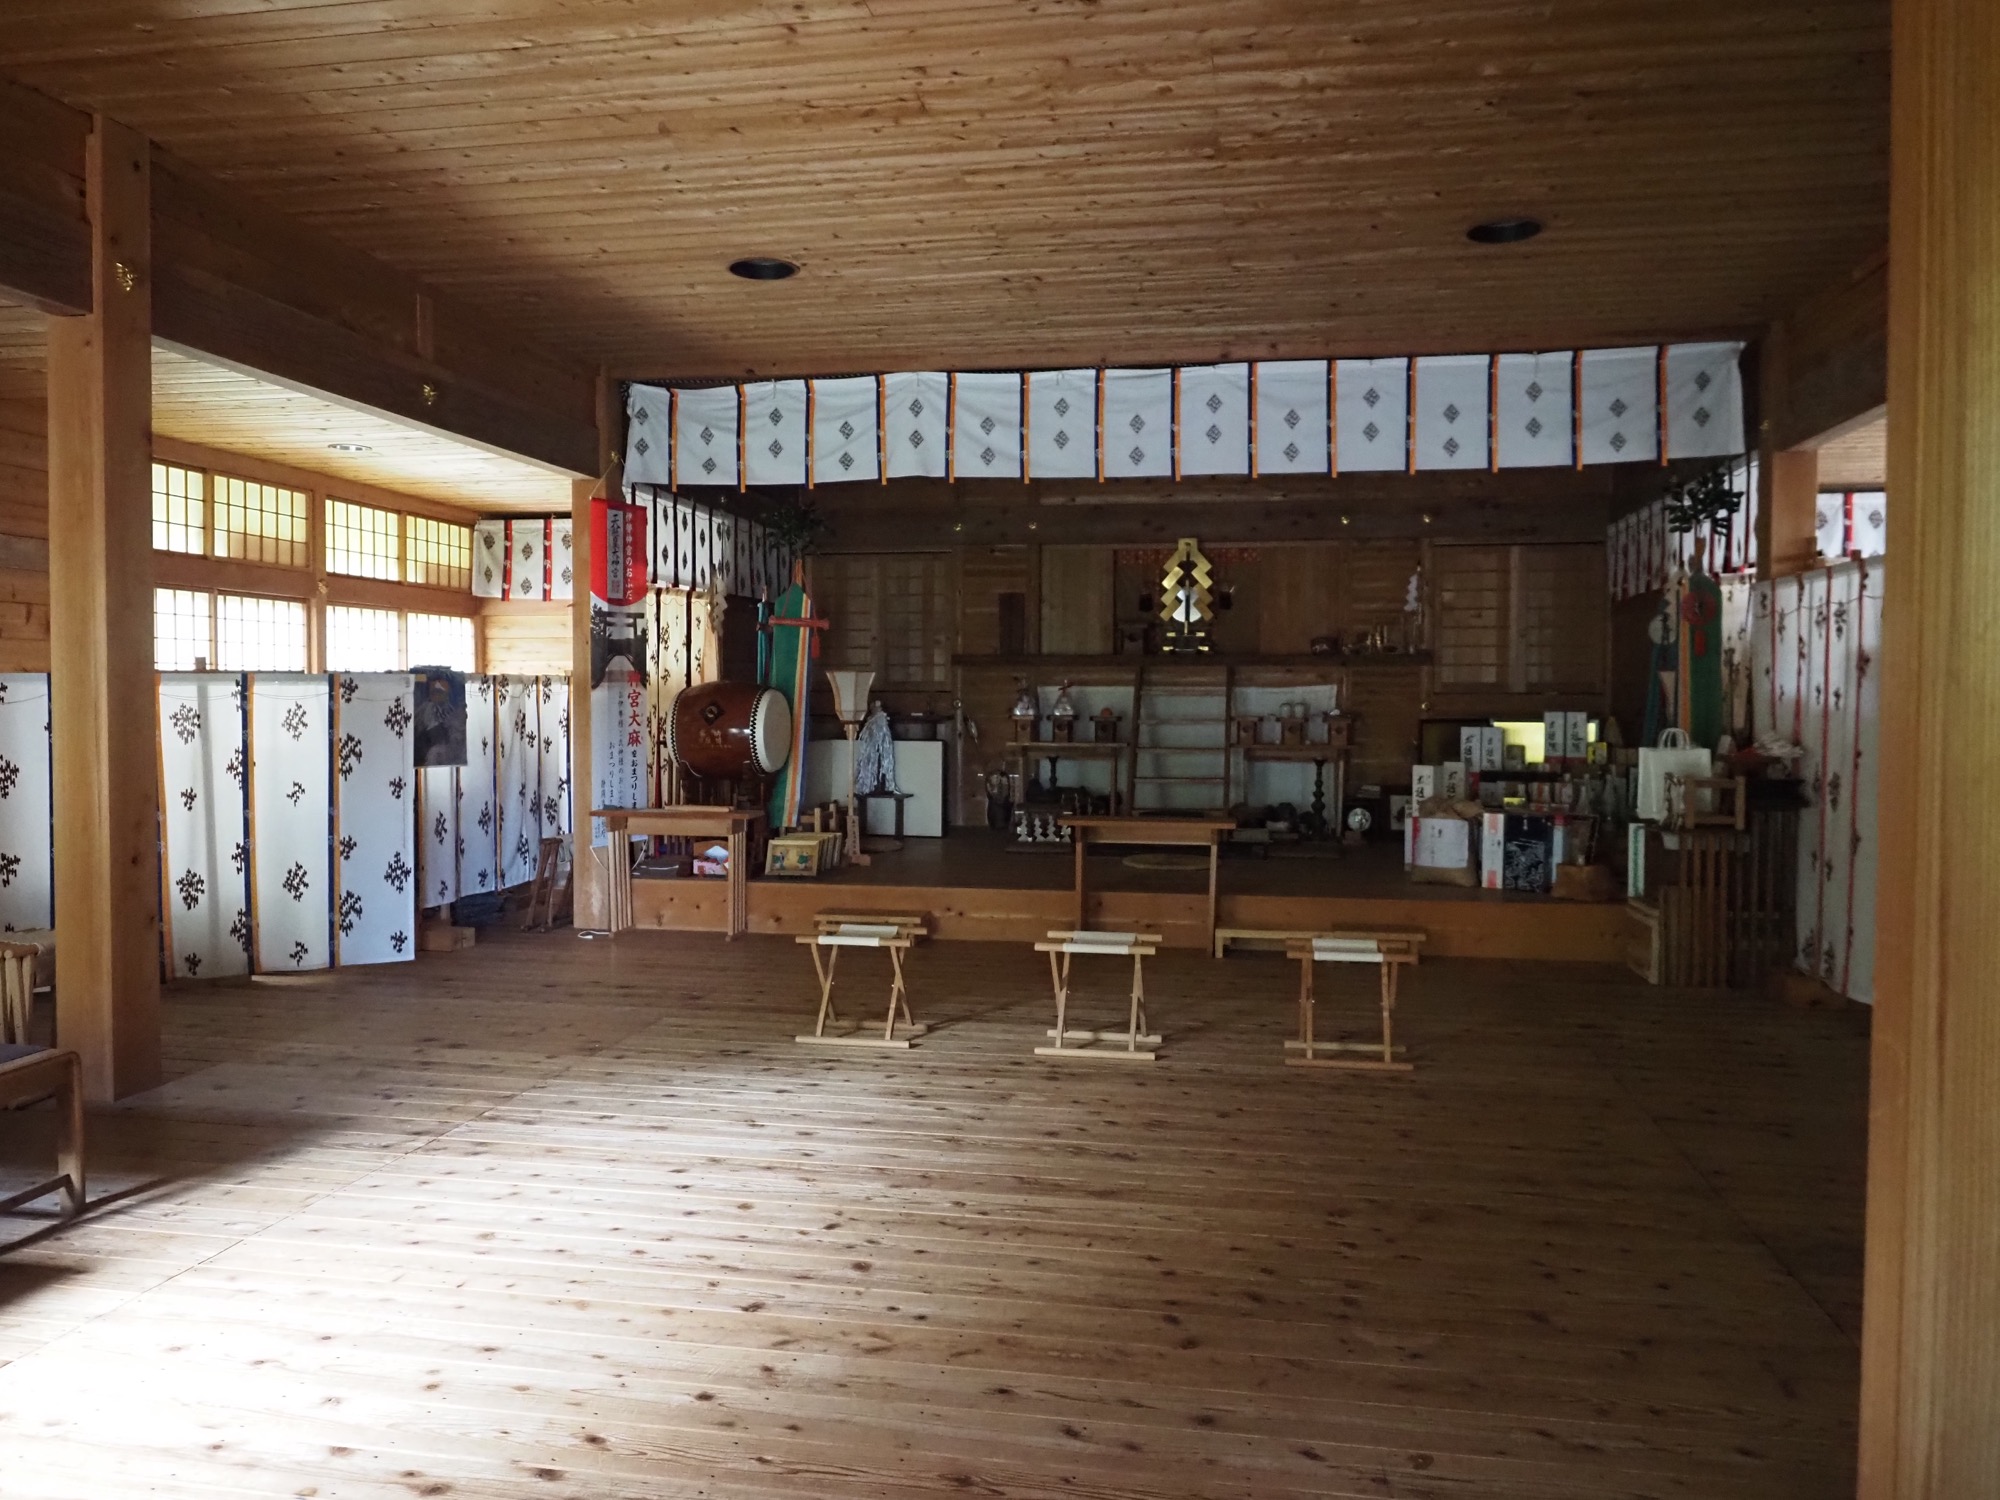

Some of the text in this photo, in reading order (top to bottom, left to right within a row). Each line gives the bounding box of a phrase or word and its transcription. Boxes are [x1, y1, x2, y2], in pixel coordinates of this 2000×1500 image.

[625, 512, 633, 601] 伊勢神宮のおふだ
